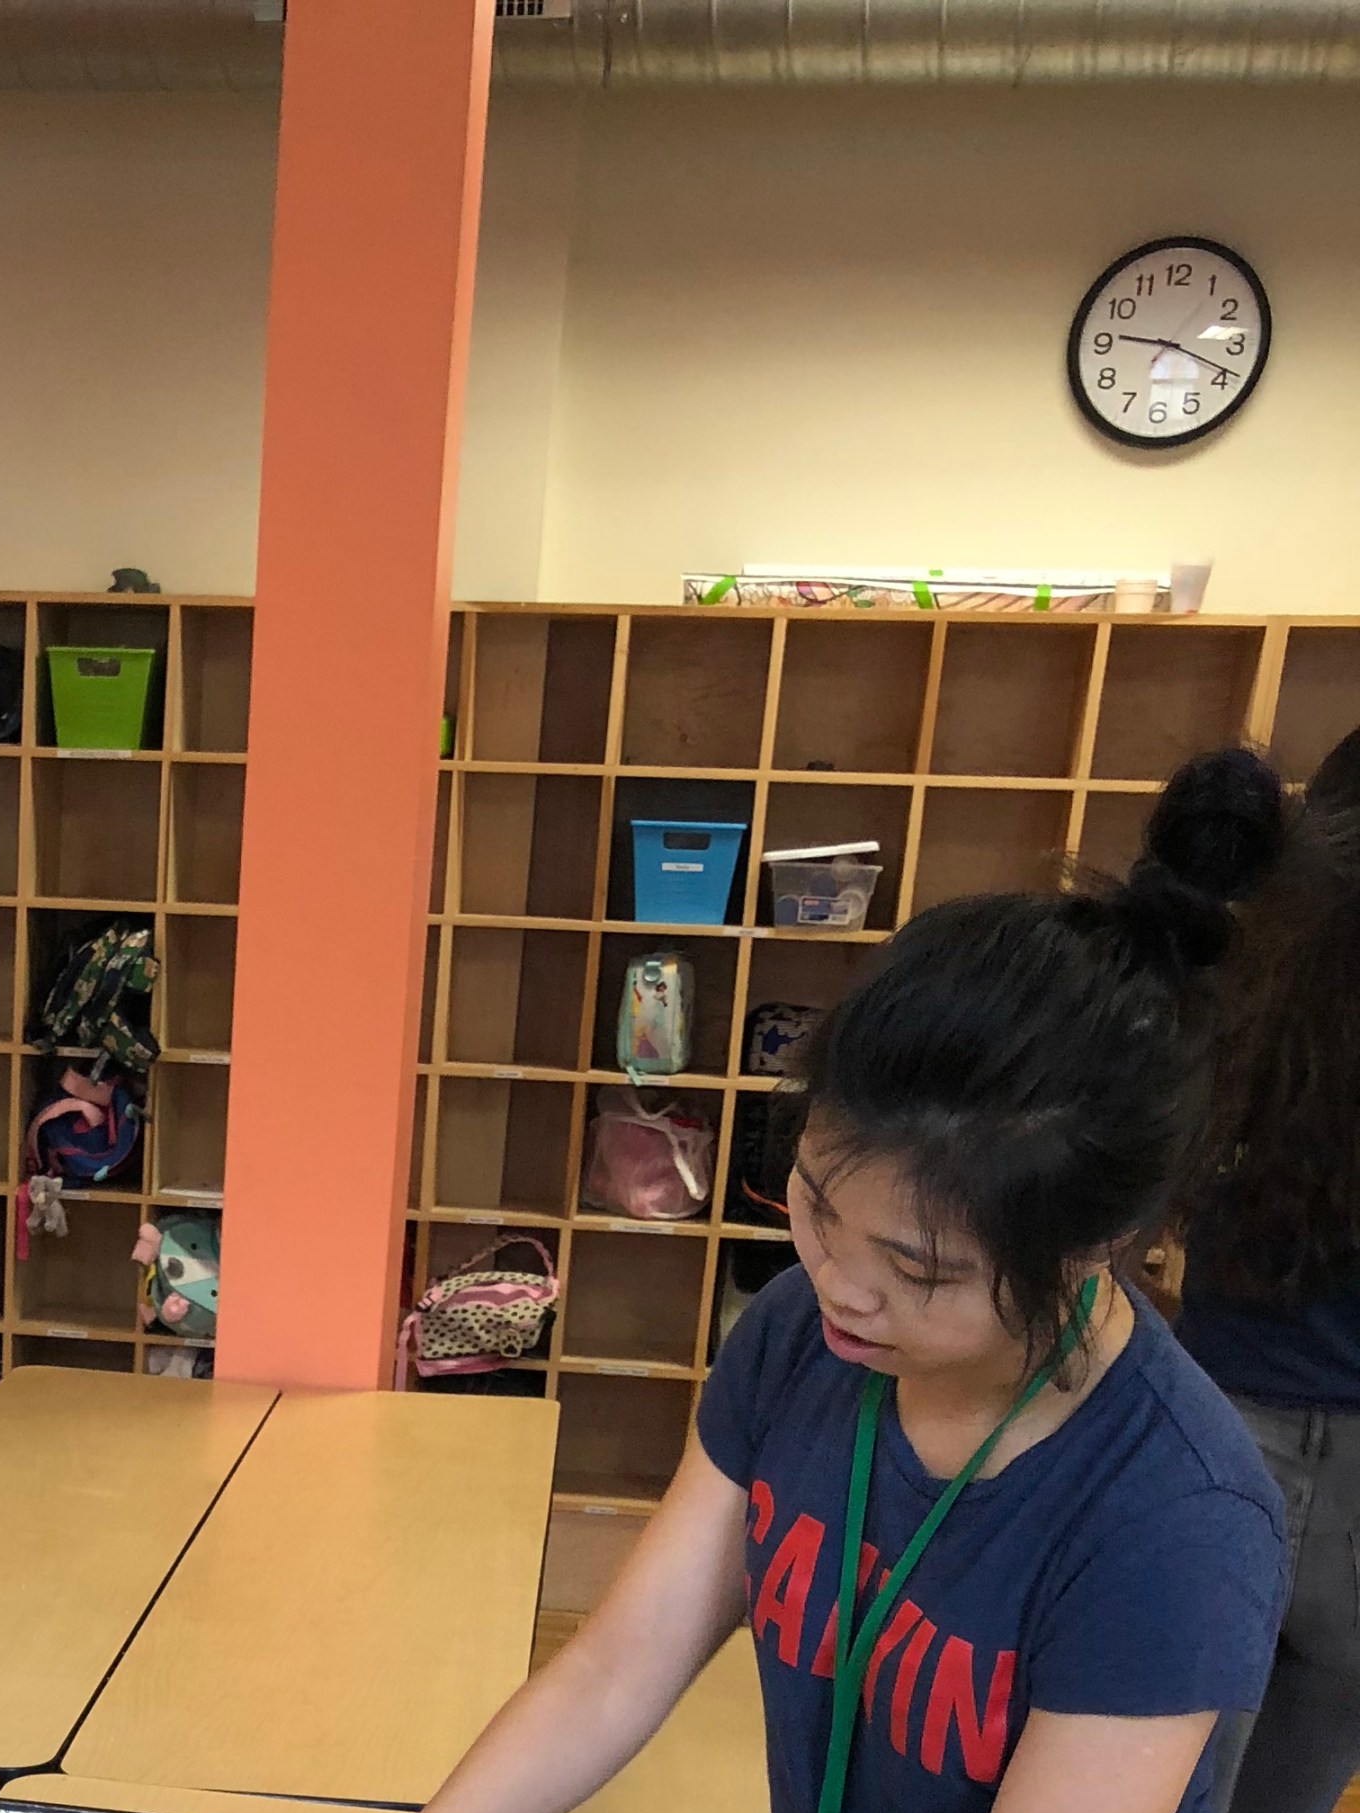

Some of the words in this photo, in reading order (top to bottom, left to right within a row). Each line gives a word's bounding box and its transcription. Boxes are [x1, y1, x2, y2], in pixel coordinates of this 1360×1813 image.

[1135, 273, 1155, 296] 11
[1165, 263, 1193, 287] 12
[1208, 274, 1217, 296] 1
[1108, 298, 1137, 320] 10
[1220, 298, 1239, 321] 2
[1093, 332, 1113, 355] 9
[1225, 332, 1246, 356] 3
[1097, 367, 1117, 390] 8
[1210, 368, 1228, 390] 4
[1122, 392, 1138, 413] 7
[1148, 401, 1167, 424] 6
[1182, 392, 1201, 415] 5
